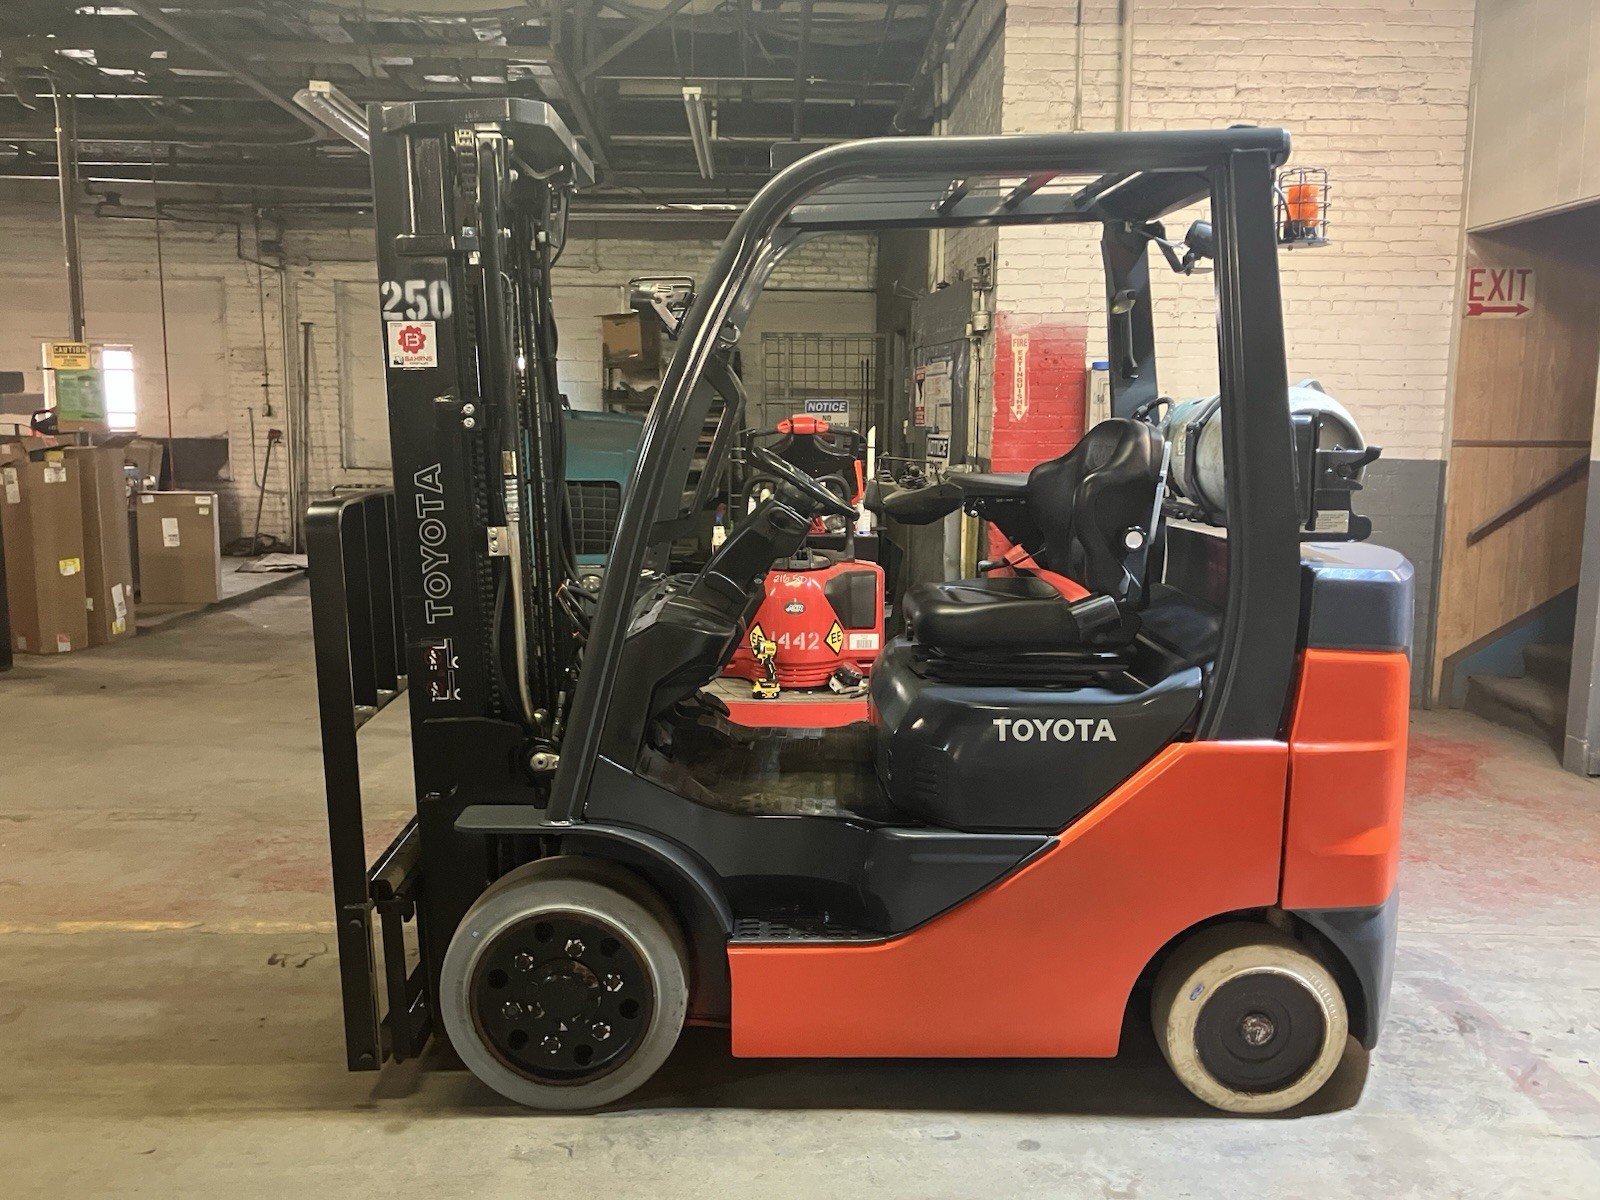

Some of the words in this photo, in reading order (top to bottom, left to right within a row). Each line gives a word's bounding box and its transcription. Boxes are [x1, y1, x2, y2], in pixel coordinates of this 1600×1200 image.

[1469, 269, 1532, 301] EXIT
[381, 280, 451, 320] 250
[1012, 338, 1028, 348] FIRE
[1016, 350, 1024, 416] EXTINGUISHER
[808, 402, 846, 411] NOTICE
[413, 463, 453, 624] TOYOTA
[831, 630, 842, 645] EE
[992, 718, 1117, 742] TOYOTA
